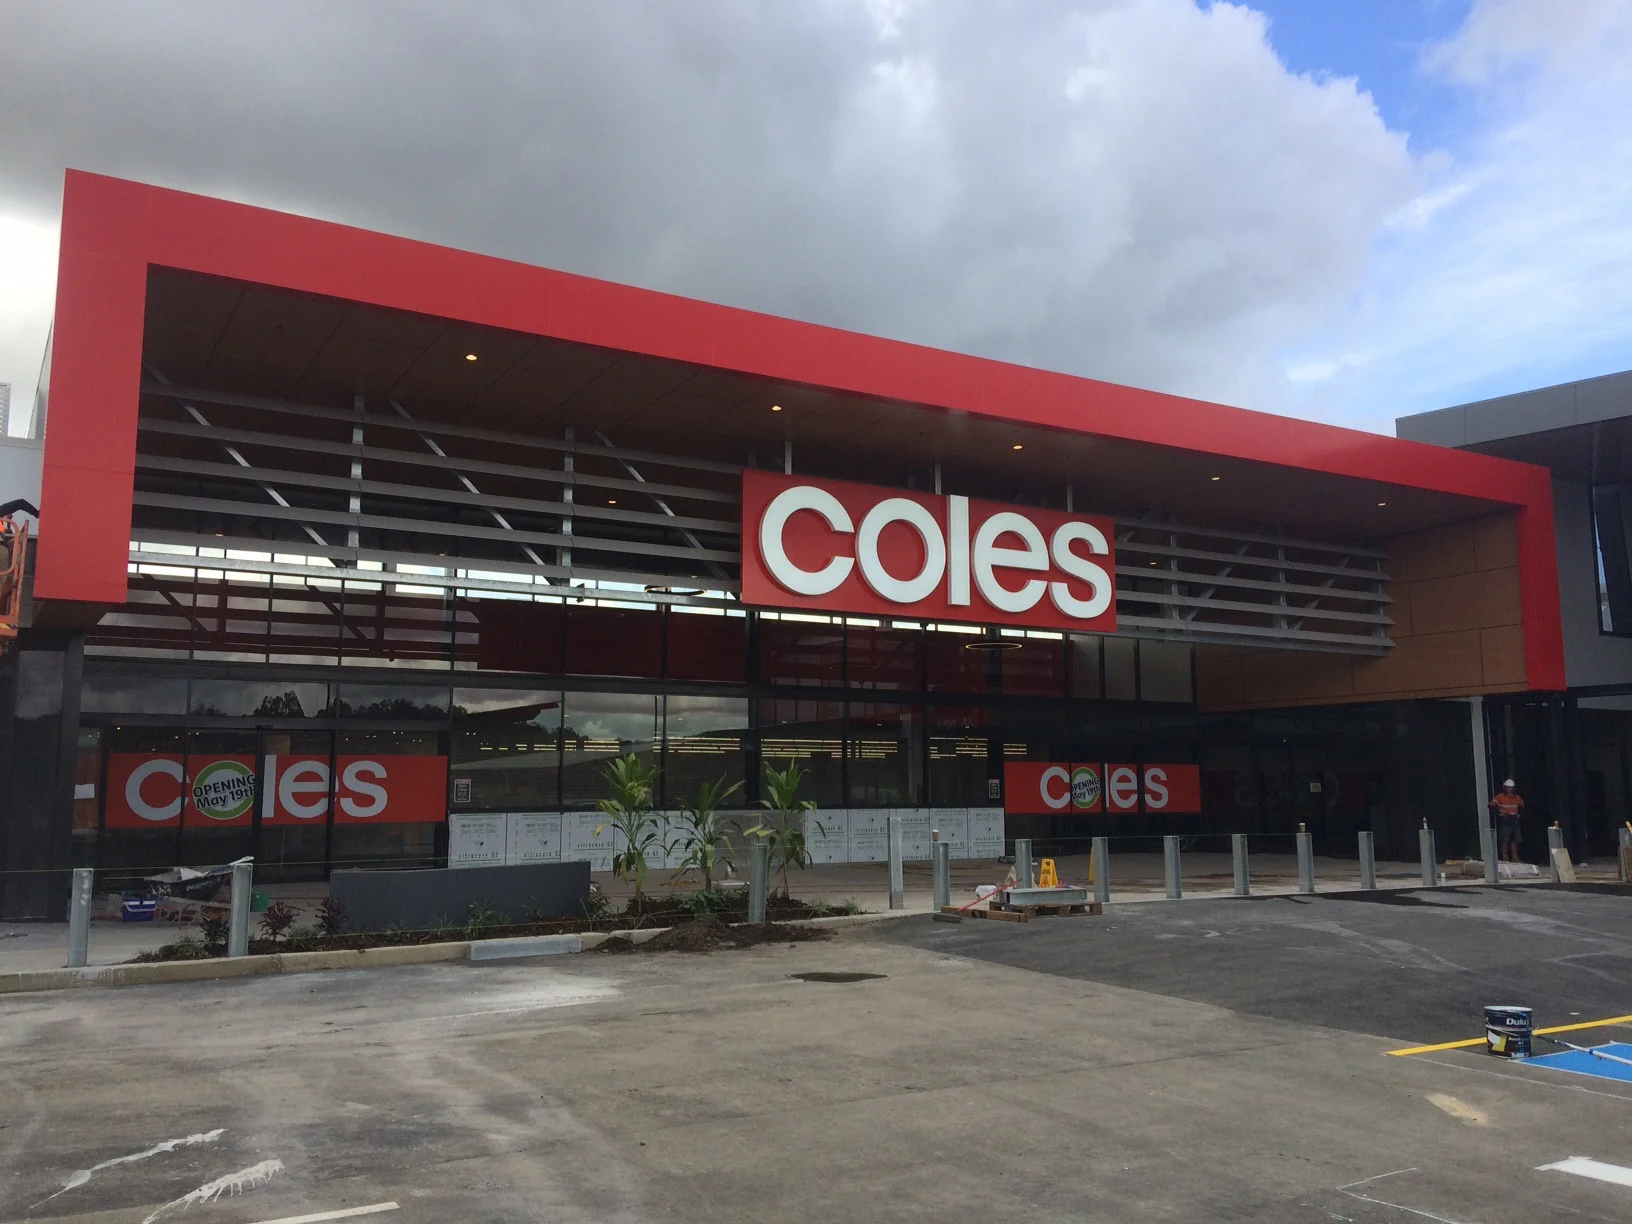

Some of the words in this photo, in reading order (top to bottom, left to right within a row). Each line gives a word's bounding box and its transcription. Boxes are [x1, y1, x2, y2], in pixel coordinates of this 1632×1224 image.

[759, 485, 1113, 620] coles
[193, 774, 256, 798] OPENING
[1072, 776, 1099, 792] PENING
[197, 795, 227, 809] May
